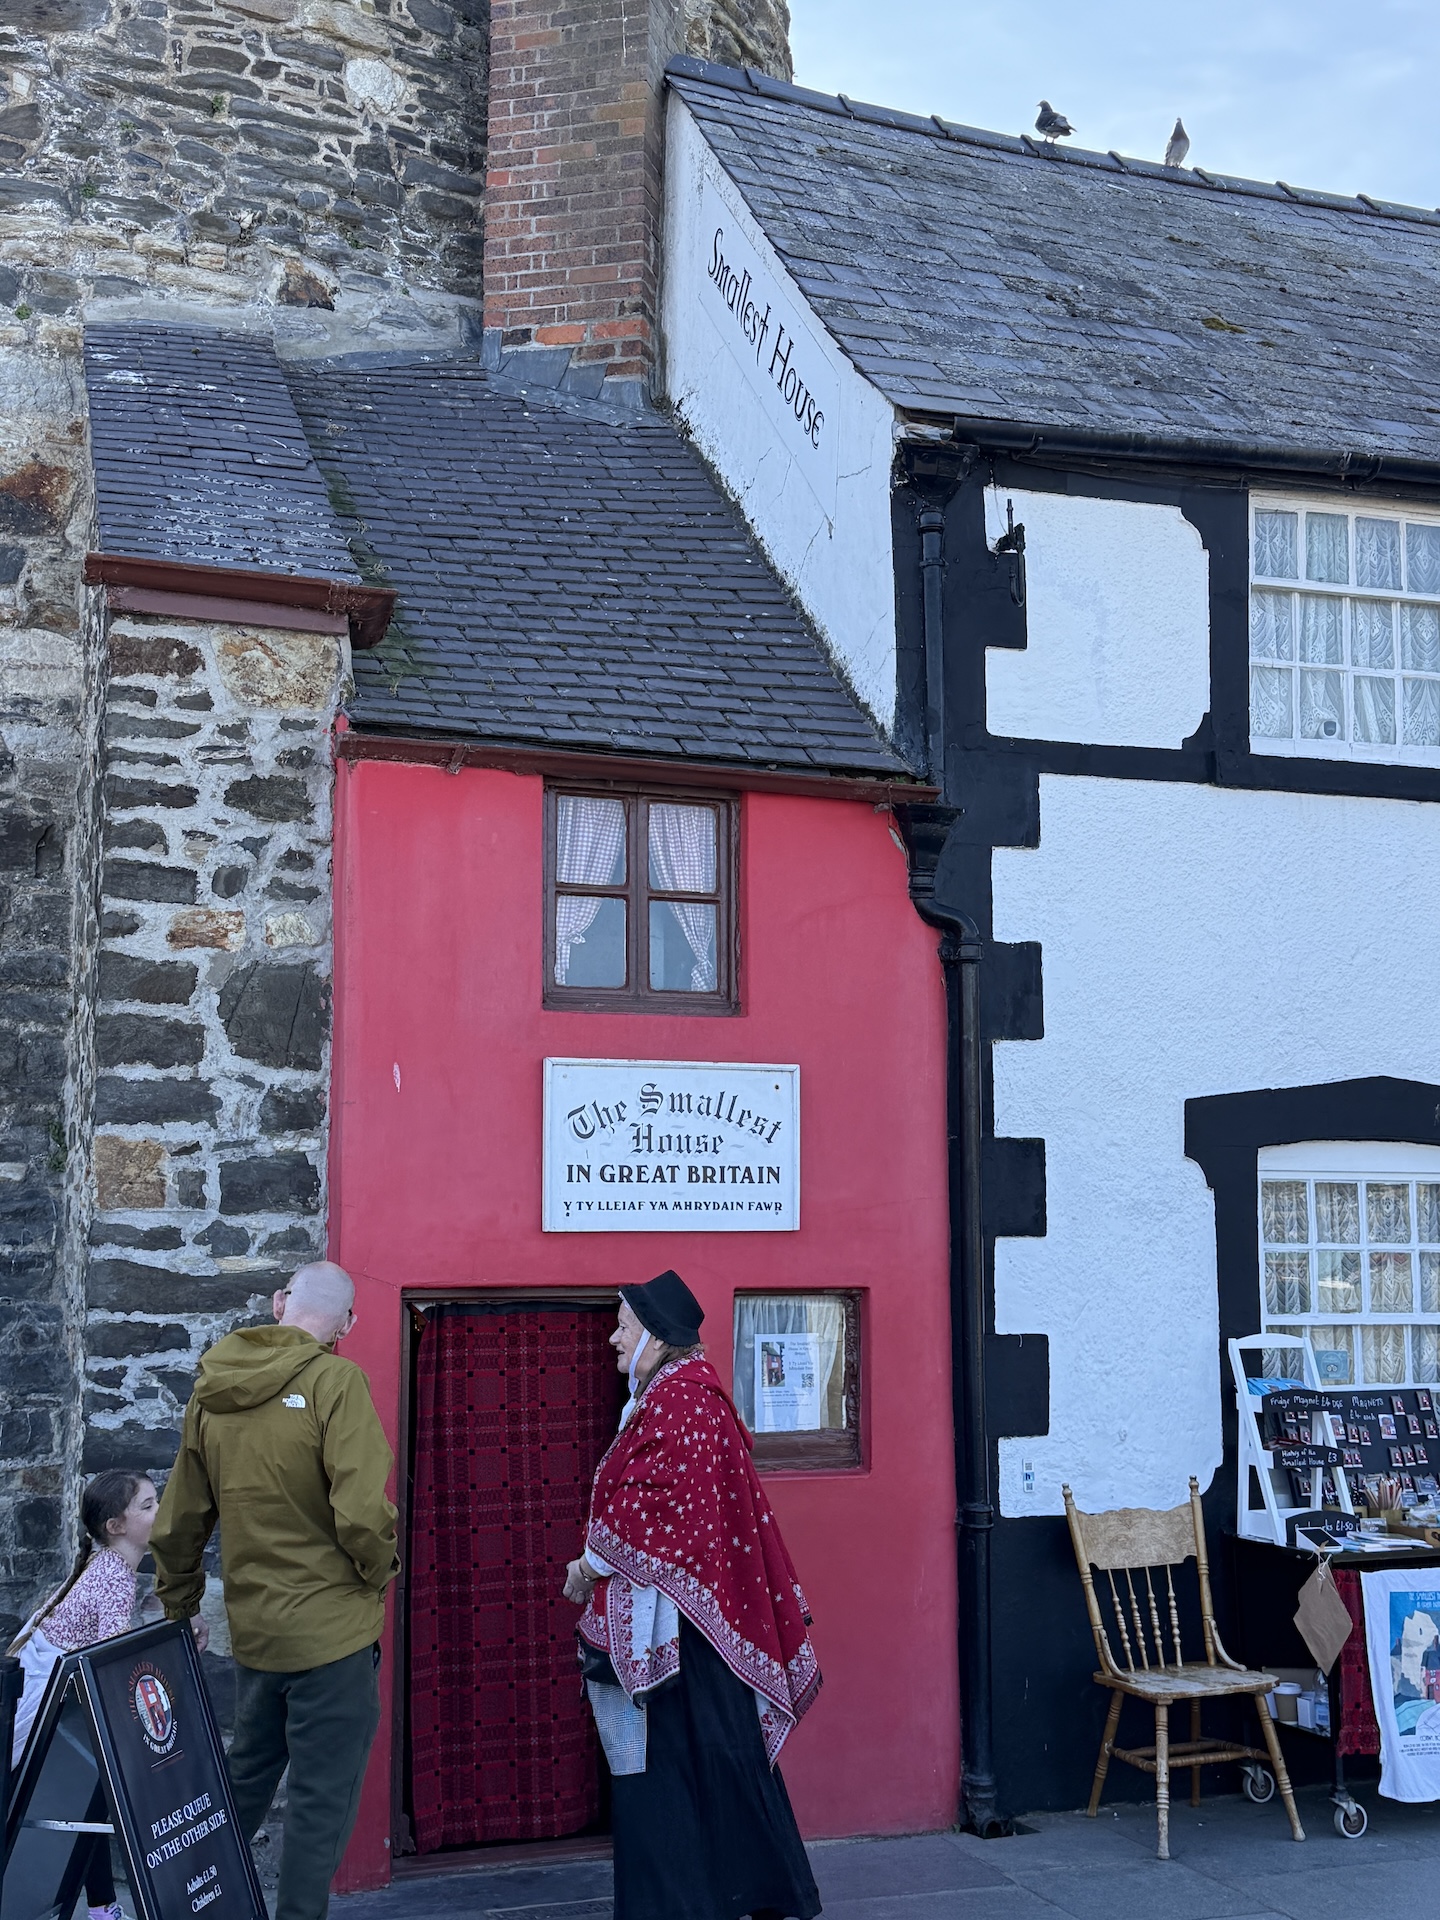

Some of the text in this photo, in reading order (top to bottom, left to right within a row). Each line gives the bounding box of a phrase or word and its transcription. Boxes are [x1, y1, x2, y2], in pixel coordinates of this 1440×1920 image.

[707, 227, 825, 450] Smallest House
[567, 1082, 783, 1144] The Smallest
[629, 1121, 725, 1155] House
[566, 1164, 781, 1184] IN GREAT BRITAIN
[563, 1201, 783, 1211] Y TY LLEIAF YM MHRYDAIN FAWR
[1293, 1394, 1320, 1407] Magnet
[1327, 1451, 1338, 1463] £3
[150, 1792, 212, 1840] PLEASE QUEUE
[146, 1809, 228, 1869] ON THE OTHER SIDE
[186, 1875, 205, 1895] Adults
[191, 1892, 216, 1913] Children
